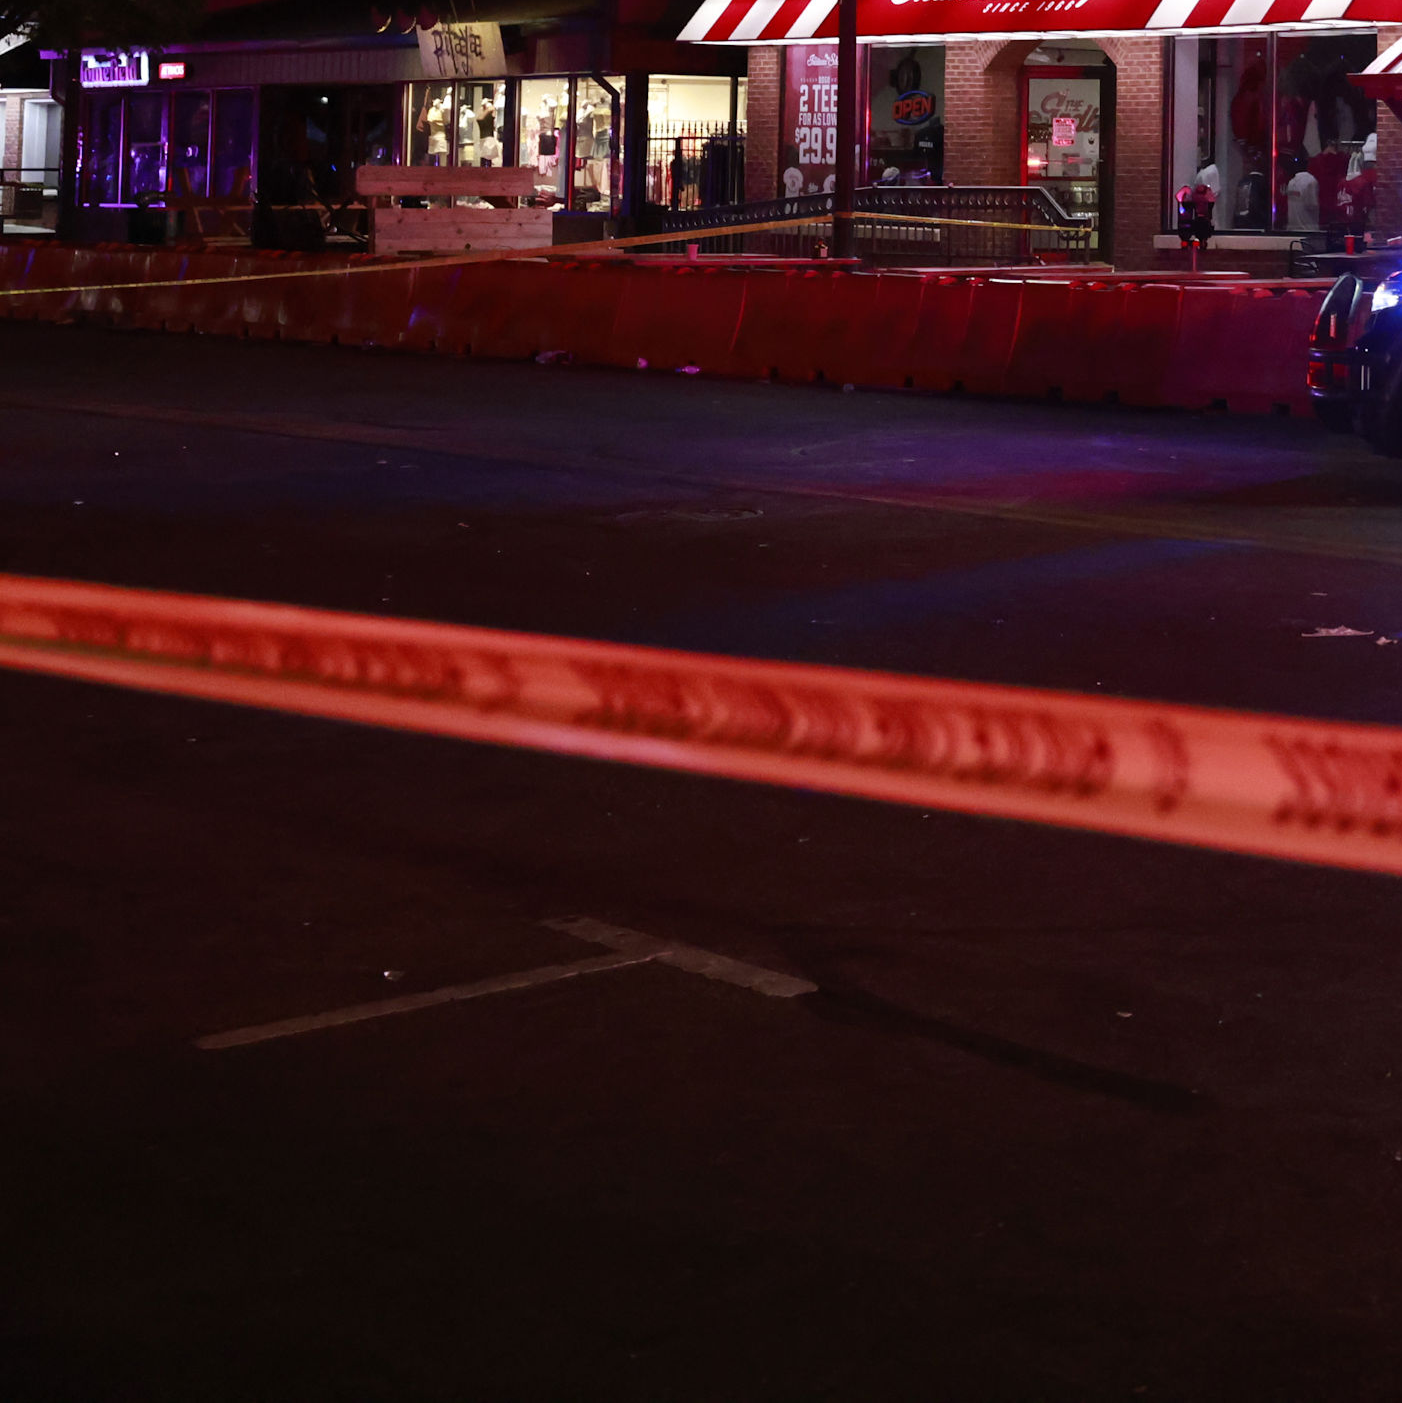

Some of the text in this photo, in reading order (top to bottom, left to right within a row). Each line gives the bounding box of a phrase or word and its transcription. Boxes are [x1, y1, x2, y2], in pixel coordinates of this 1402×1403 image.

[982, 0, 1076, 13] SINCE 1966
[800, 84, 838, 112] 2 TEE
[892, 96, 932, 119] OPEN
[799, 112, 838, 126] FOR AS LOW
[795, 127, 837, 165] $29.9
